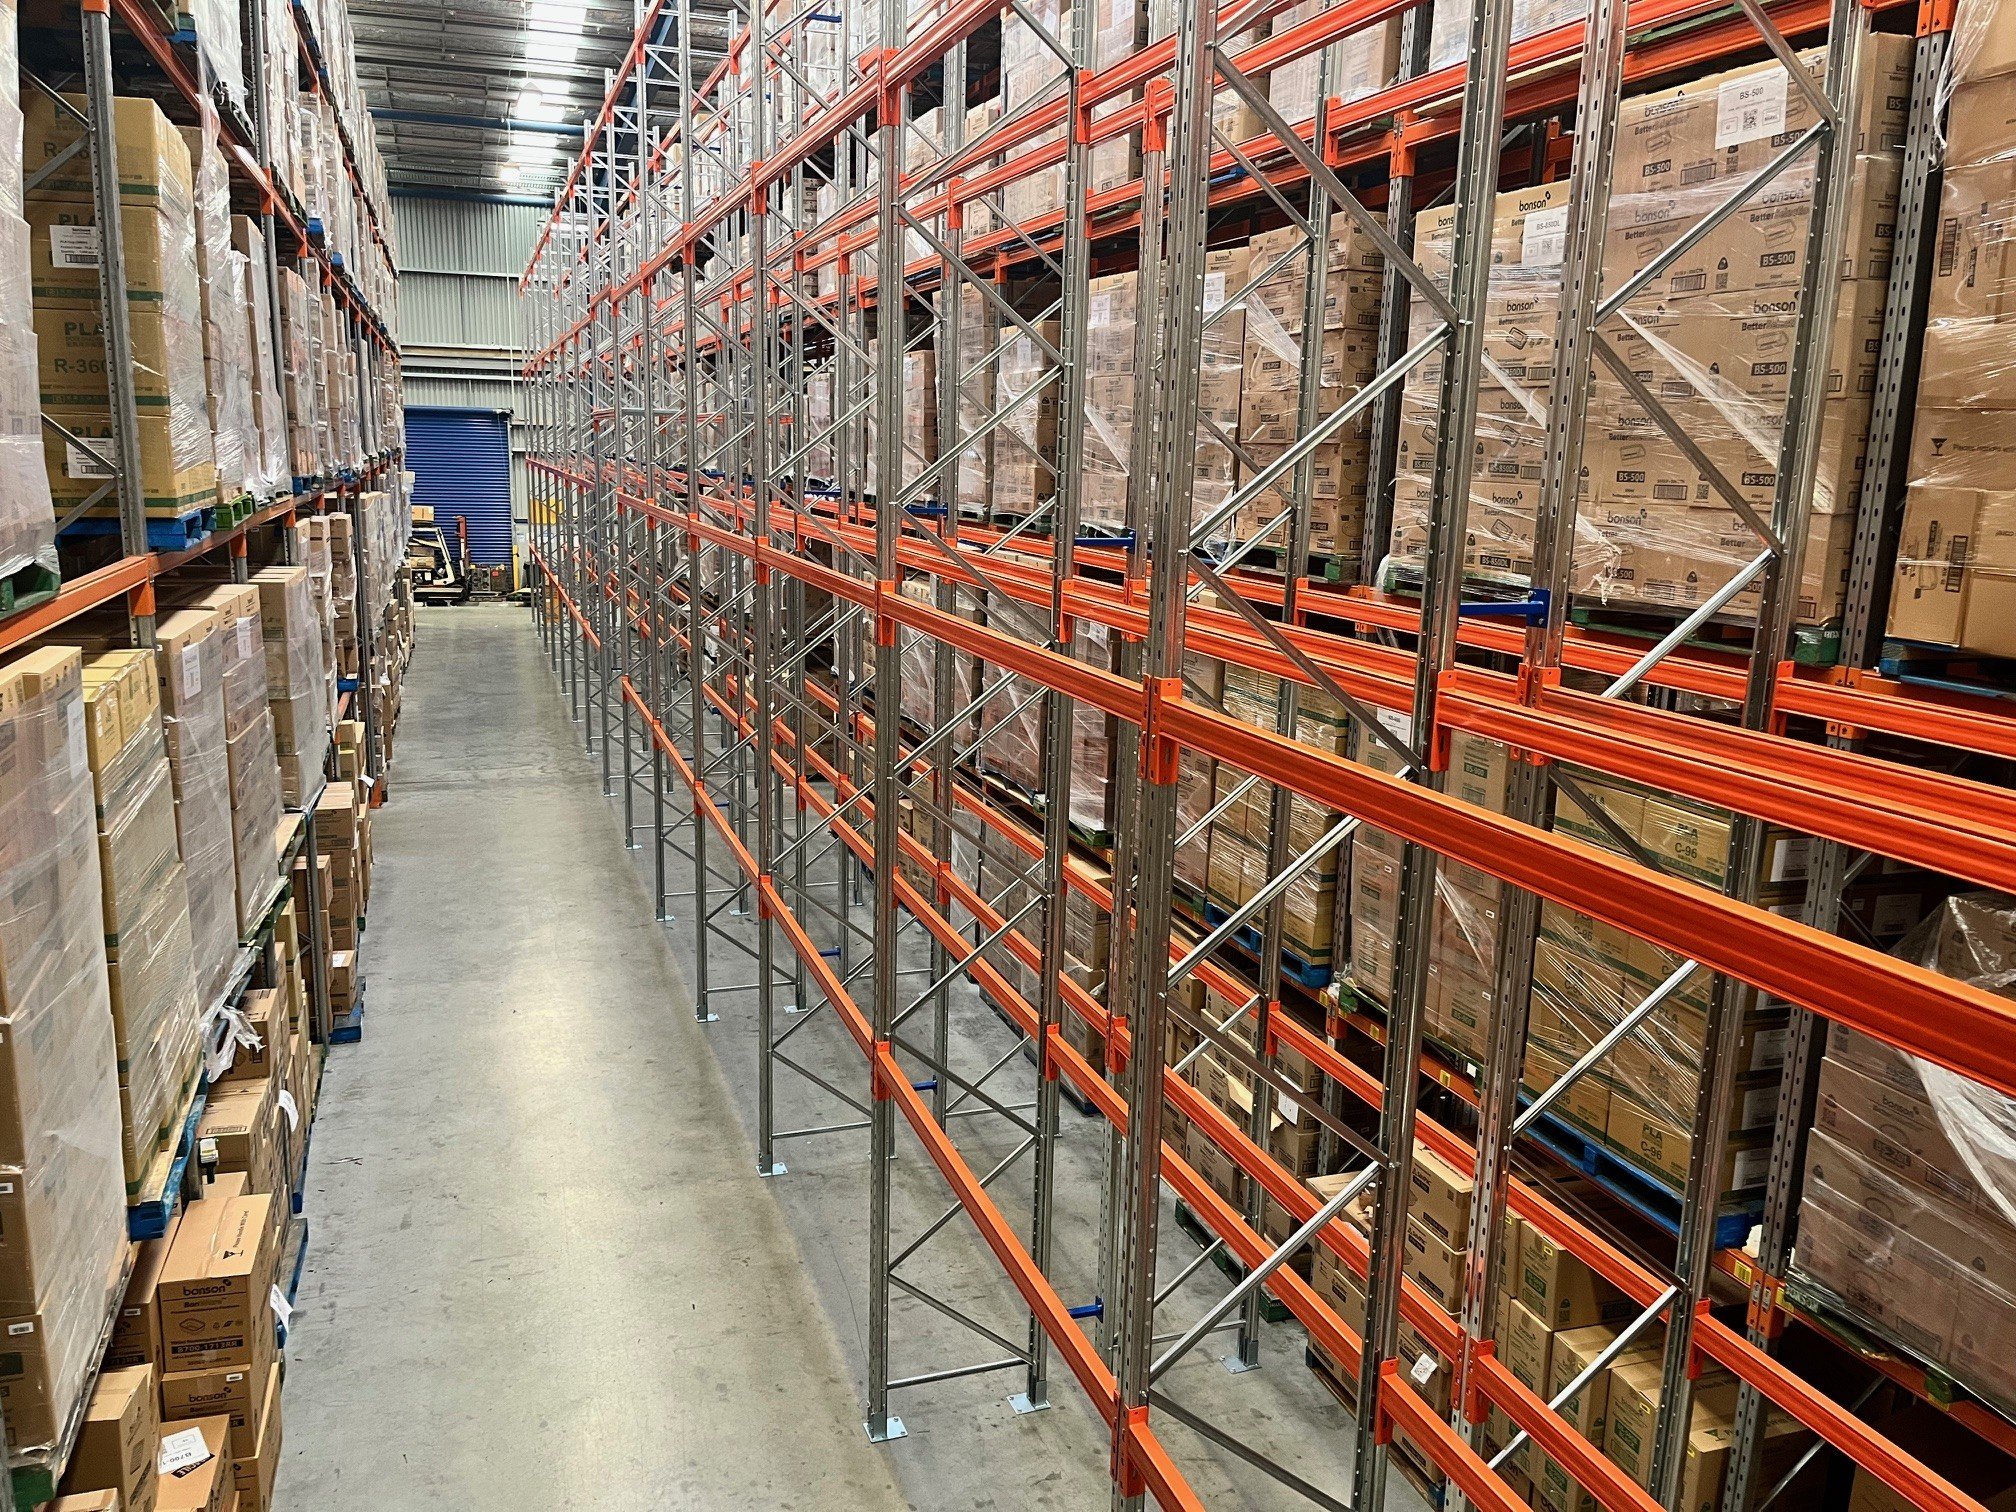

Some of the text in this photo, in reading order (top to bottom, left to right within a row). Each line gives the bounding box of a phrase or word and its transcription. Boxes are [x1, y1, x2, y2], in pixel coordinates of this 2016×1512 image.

[1740, 87, 1764, 100] BS-500
[1644, 162, 1670, 176] BS-500
[1519, 198, 1547, 212] bonson
[1438, 216, 1454, 227] bons
[1635, 209, 1669, 223] bonson
[1762, 253, 1795, 266] BS-500
[1506, 300, 1534, 312] bonson
[1753, 300, 1796, 314] bonson
[1754, 364, 1786, 375] BS-500
[1617, 471, 1645, 483] BS-500
[1416, 488, 1431, 498] bons
[1492, 491, 1518, 505] bonson
[1607, 510, 1642, 526] bonson
[1674, 842, 1698, 859] C-96
[1642, 1123, 1663, 1142] PLA
[1641, 1141, 1662, 1160] C-96
[183, 1285, 226, 1296] bonson
[189, 1389, 227, 1402] bonson
